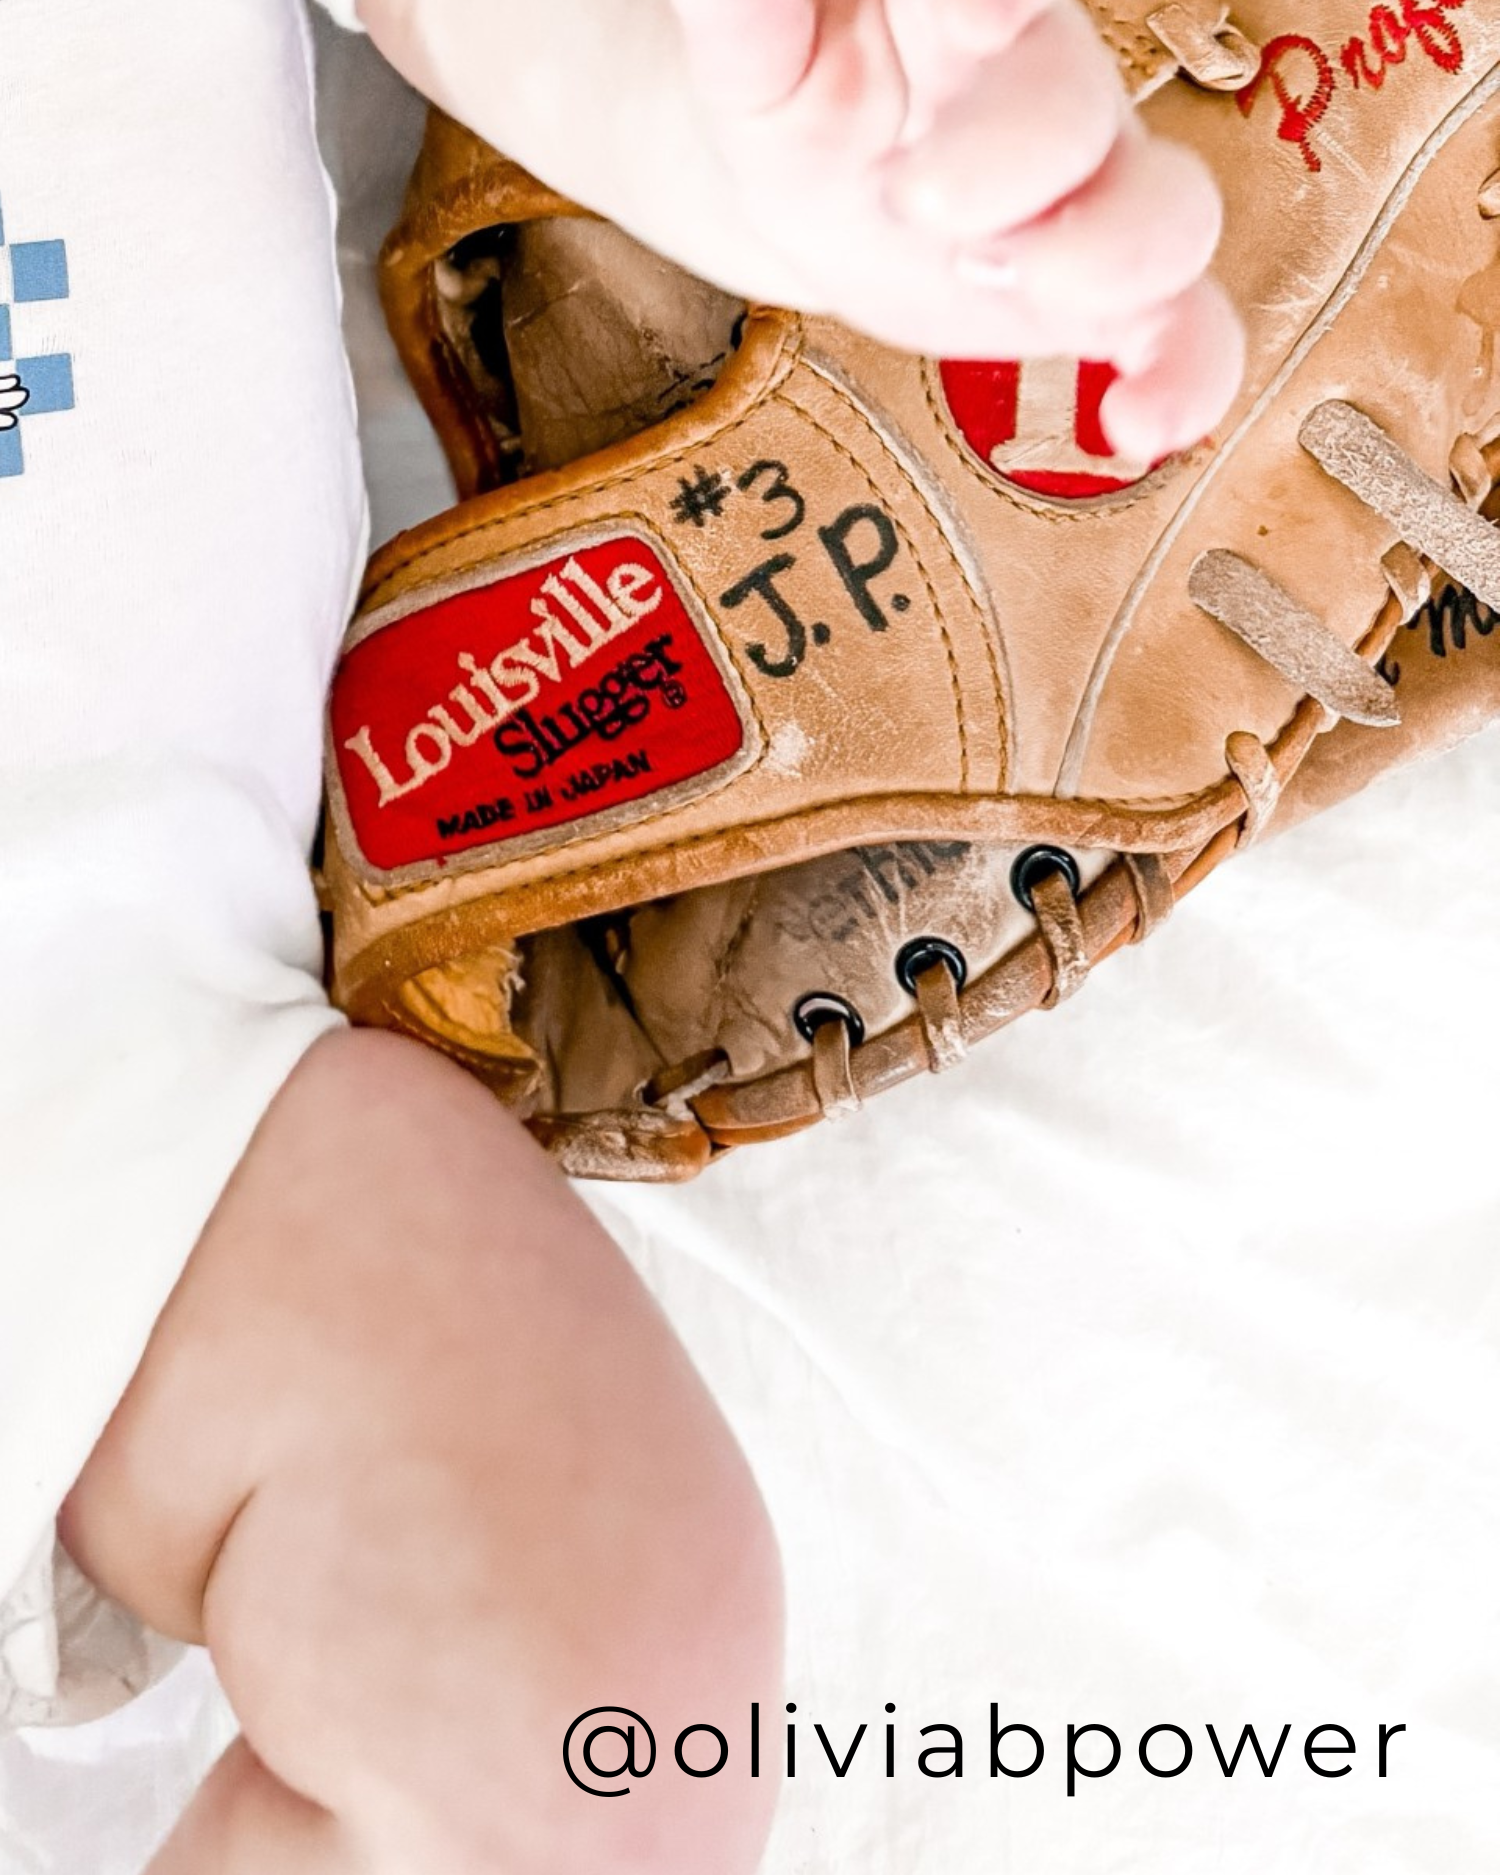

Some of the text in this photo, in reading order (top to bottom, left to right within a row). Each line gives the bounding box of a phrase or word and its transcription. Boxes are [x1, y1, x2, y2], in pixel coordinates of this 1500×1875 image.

[668, 458, 806, 540] #3
[719, 501, 911, 678] J.P.
[344, 554, 662, 809] Louisville
[435, 749, 653, 840] MADE IN JAPAN
